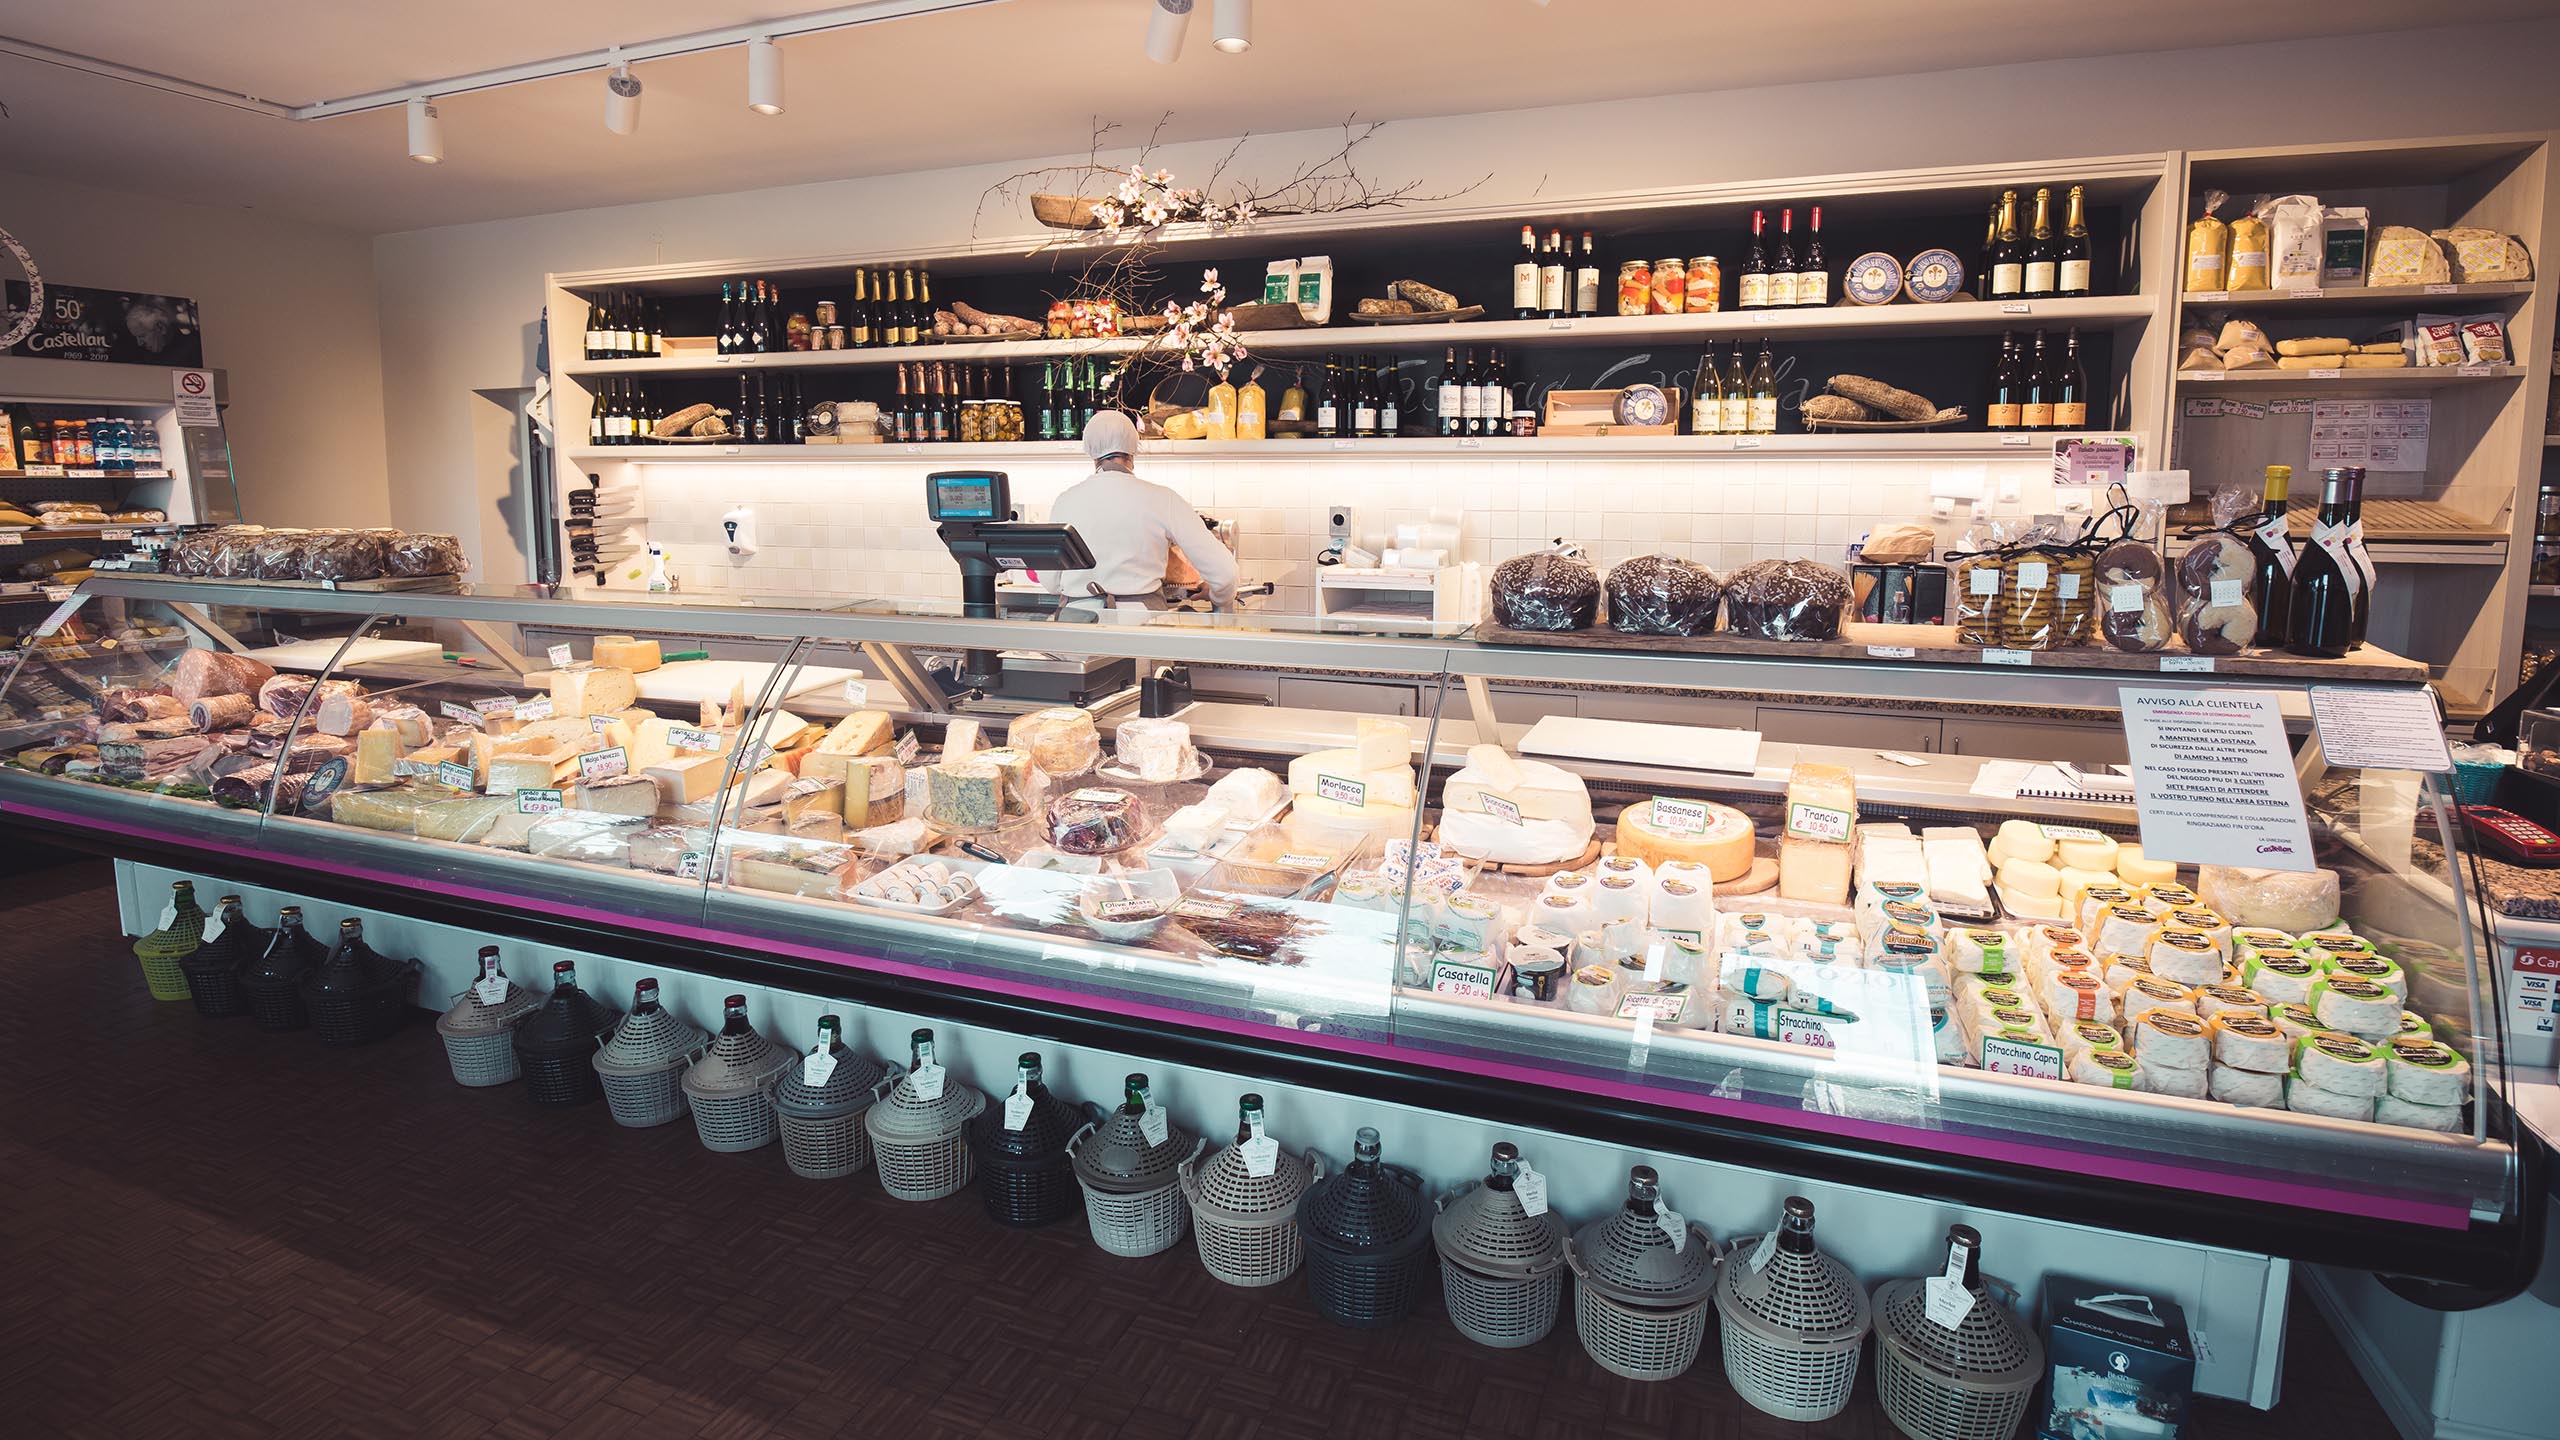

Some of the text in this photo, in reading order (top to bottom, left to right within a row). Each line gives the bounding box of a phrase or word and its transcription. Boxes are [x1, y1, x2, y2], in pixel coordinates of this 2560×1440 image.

[55, 299, 81, 320] 50
[27, 331, 113, 352] Castellan
[63, 351, 109, 362] 1969 2019
[2137, 697, 2263, 710] AVVISO ALLA CLIENTELA
[2165, 735, 2208, 743] MANTENERE
[2221, 738, 2256, 746] DISTANZA
[585, 755, 600, 764] Malga
[2240, 771, 2285, 779] ALL'INTERNO
[1321, 778, 1361, 795] Morlacco
[2186, 784, 2216, 793] PREGATI
[2227, 787, 2269, 796] ATTENDERE
[2158, 793, 2187, 801] VOSTRO
[2188, 795, 2215, 803] TURNO
[2216, 797, 2255, 805] NELL'AREA
[2256, 799, 2290, 807] ESTERNA
[1656, 801, 1703, 819] Bassanese
[1804, 807, 1839, 824] Trancio
[1657, 815, 1663, 823] €
[1695, 822, 1703, 831] kg
[2186, 820, 2232, 829] RINGRAZIAMO
[2192, 812, 2239, 821] COMPRENSIONE
[2244, 815, 2297, 824] COLLABORAZIONE
[1795, 820, 1803, 828] €
[1837, 828, 1845, 837] kg
[2256, 845, 2295, 854] Castellan
[1128, 899, 1151, 907] Miste
[1437, 966, 1490, 985] Casatella
[1437, 982, 1445, 991] €
[1454, 983, 1471, 995] 9,50
[1480, 990, 1489, 999] kg
[2526, 980, 2546, 989] VISA
[1626, 994, 1651, 1005] Ricotta
[1652, 996, 1660, 1004] di
[1662, 997, 1681, 1009] Capra
[2523, 999, 2542, 1007] VISA
[1779, 1014, 1822, 1031] Stracchino
[1784, 1032, 1793, 1042] €
[1804, 1033, 1825, 1047] 9,50
[1986, 1043, 2058, 1065] Stracchino Capra
[1990, 1061, 2000, 1072] €
